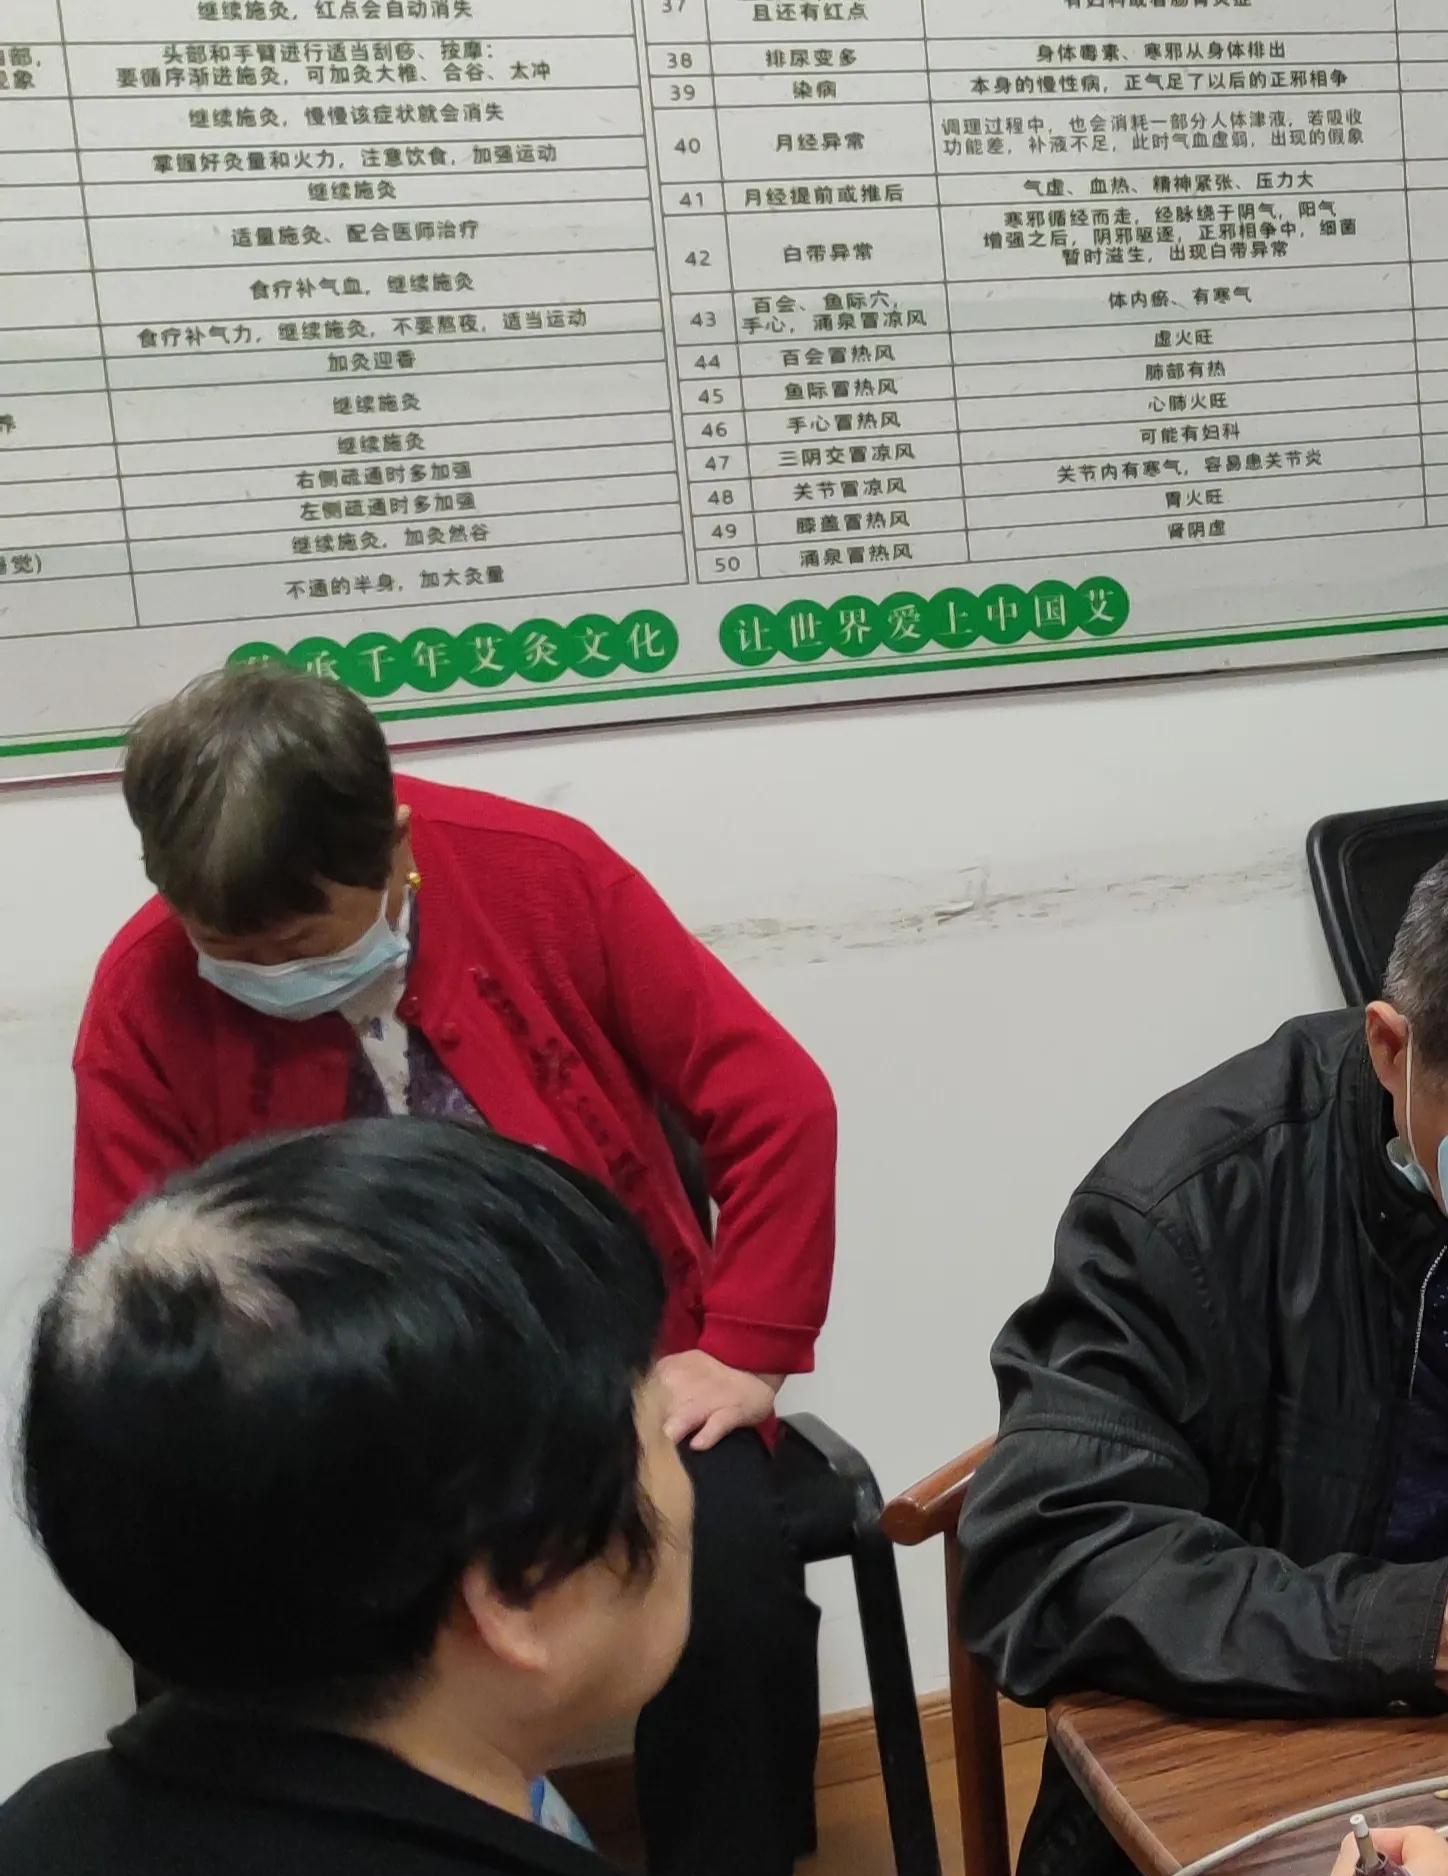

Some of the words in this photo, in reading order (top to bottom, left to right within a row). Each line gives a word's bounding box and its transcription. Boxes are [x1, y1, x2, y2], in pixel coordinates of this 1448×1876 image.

[662, 0, 685, 13] 37
[752, 2, 868, 21] 且还有红点
[666, 53, 693, 69] 38
[766, 48, 857, 67] 排尿变多
[670, 85, 695, 101] 39
[792, 80, 836, 99] 染病
[674, 138, 700, 154] 40
[776, 132, 865, 152] 月经异常
[308, 179, 396, 201] 继续施灸
[679, 192, 704, 208] 41
[745, 183, 905, 207] 月经提前或推后
[684, 250, 712, 267] 42
[783, 242, 873, 263] 白带异常
[690, 311, 717, 328] 43
[1154, 329, 1214, 347] 虚火旺
[328, 350, 416, 372] 加灸迎香
[694, 354, 721, 370] 44
[783, 344, 896, 368] 百会冒热风
[1145, 359, 1226, 381] 肺部有热
[698, 388, 724, 404] 45
[785, 378, 899, 401] 鱼际冒热风
[333, 392, 421, 415] 继续施灸
[701, 422, 728, 438] 46
[787, 411, 901, 435] 手心冒热风
[337, 431, 425, 455] 继续施灸
[1139, 421, 1241, 446] 可能有妇科
[705, 455, 730, 472] 47
[778, 443, 916, 467] 三阴交冒凉风
[707, 490, 734, 505] 48
[794, 477, 908, 501] 关节冒凉风
[1165, 488, 1224, 509] 胃火旺
[711, 523, 737, 539] 49
[797, 509, 911, 536] 膝盖冒热风
[1168, 518, 1227, 539] 肾阴虚
[715, 556, 741, 573] 50
[800, 543, 914, 568] 涌泉冒热风
[738, 588, 1116, 656] 让世界爱上中国艾
[236, 622, 666, 686] 承千年艾灸文化
